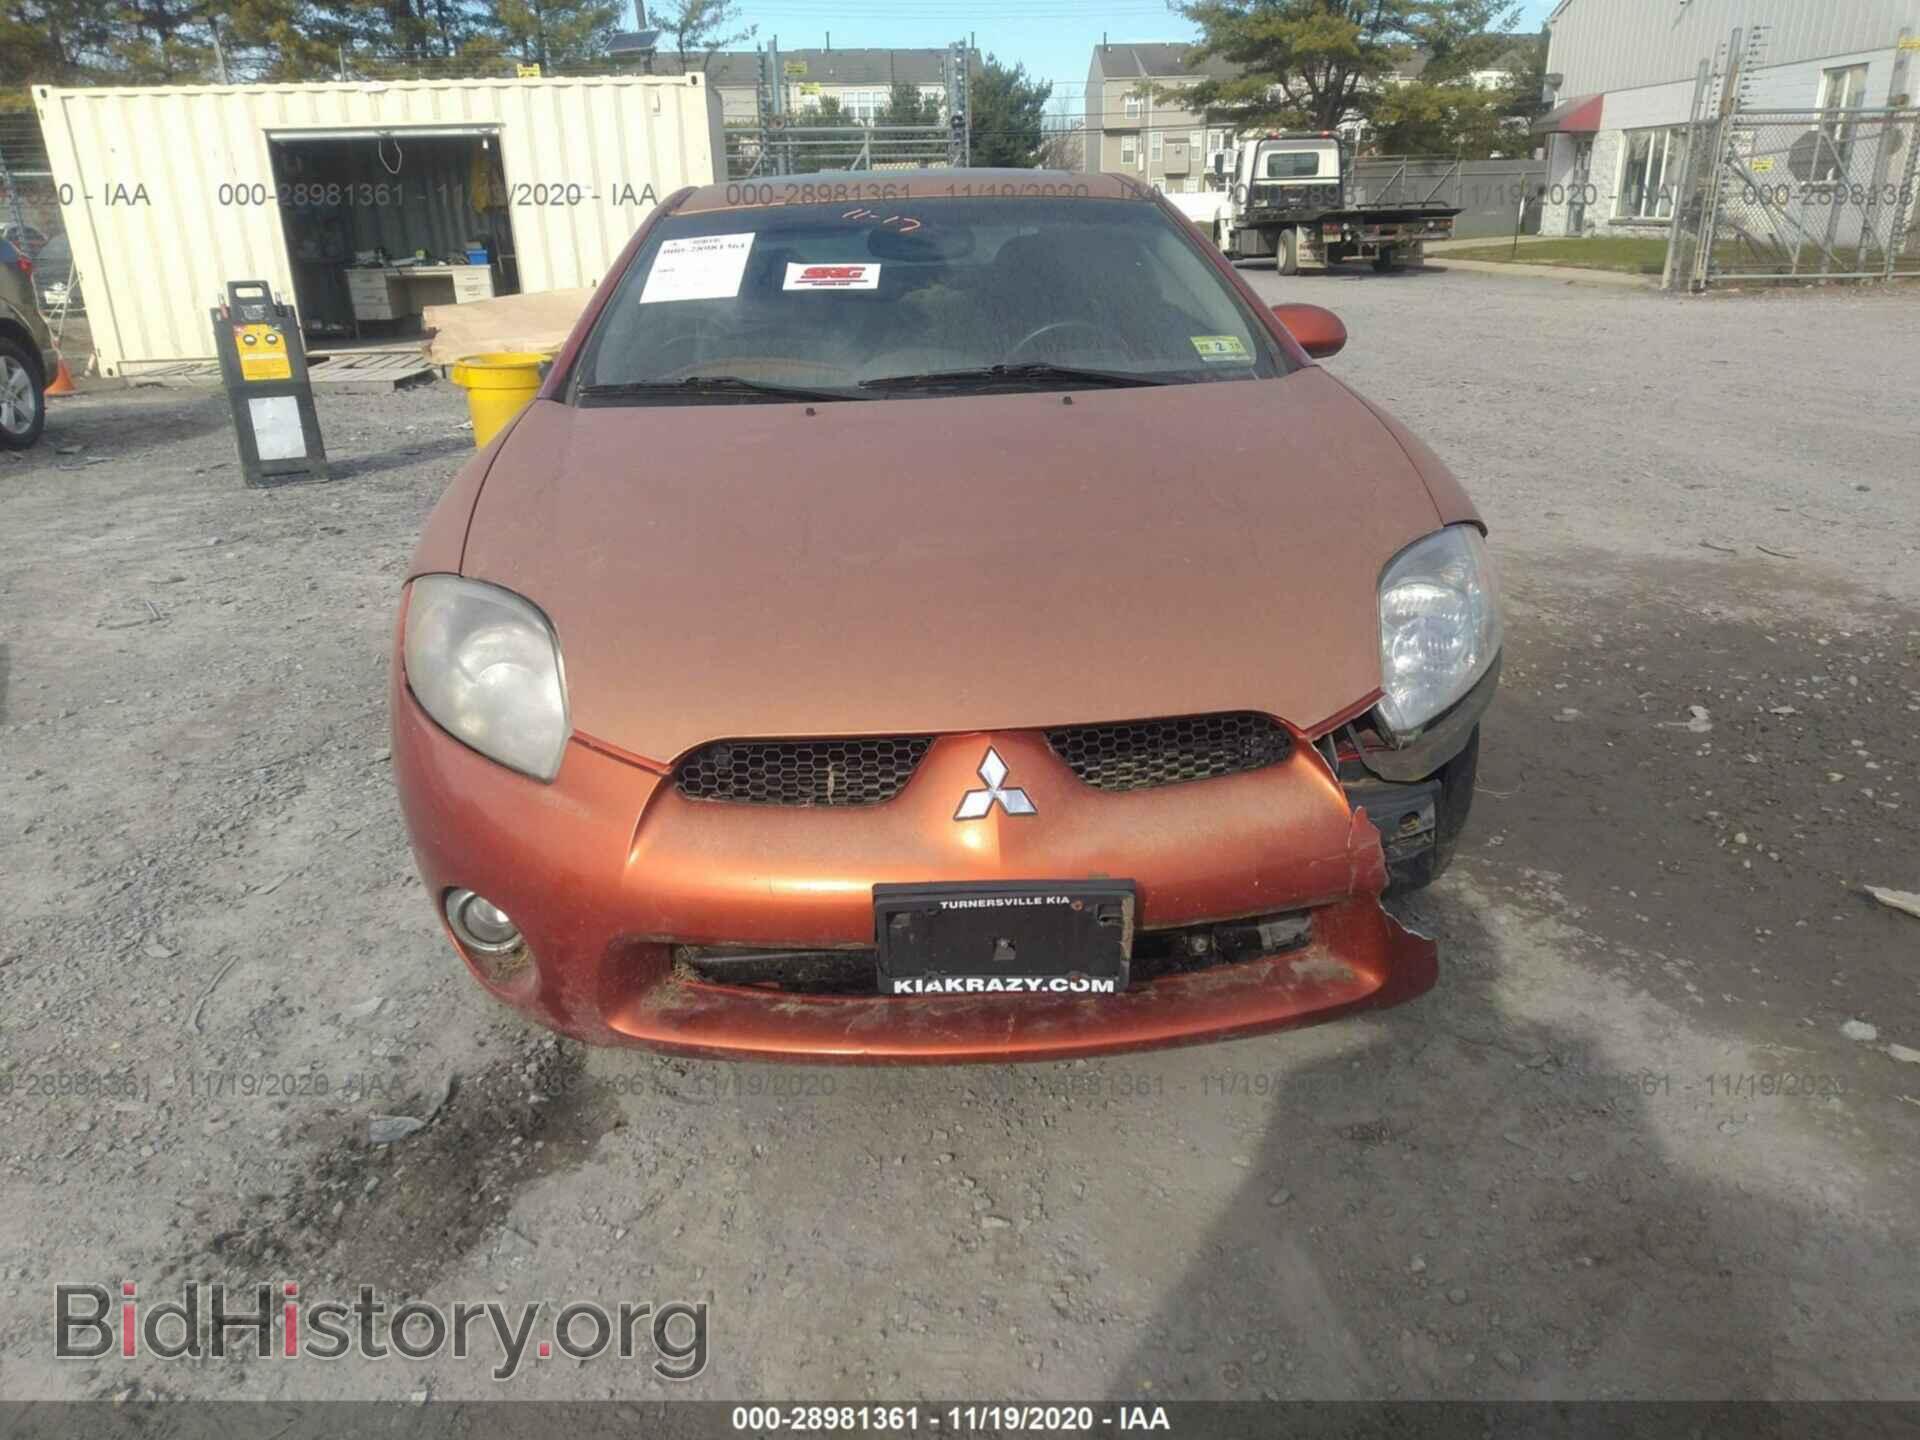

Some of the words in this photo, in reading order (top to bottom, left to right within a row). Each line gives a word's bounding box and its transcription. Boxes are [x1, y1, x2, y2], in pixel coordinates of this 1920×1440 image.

[940, 896, 1043, 909] TURNERSVILLE
[1045, 896, 1071, 906] KIA
[894, 977, 1115, 994] KIAKRAZY.COM
